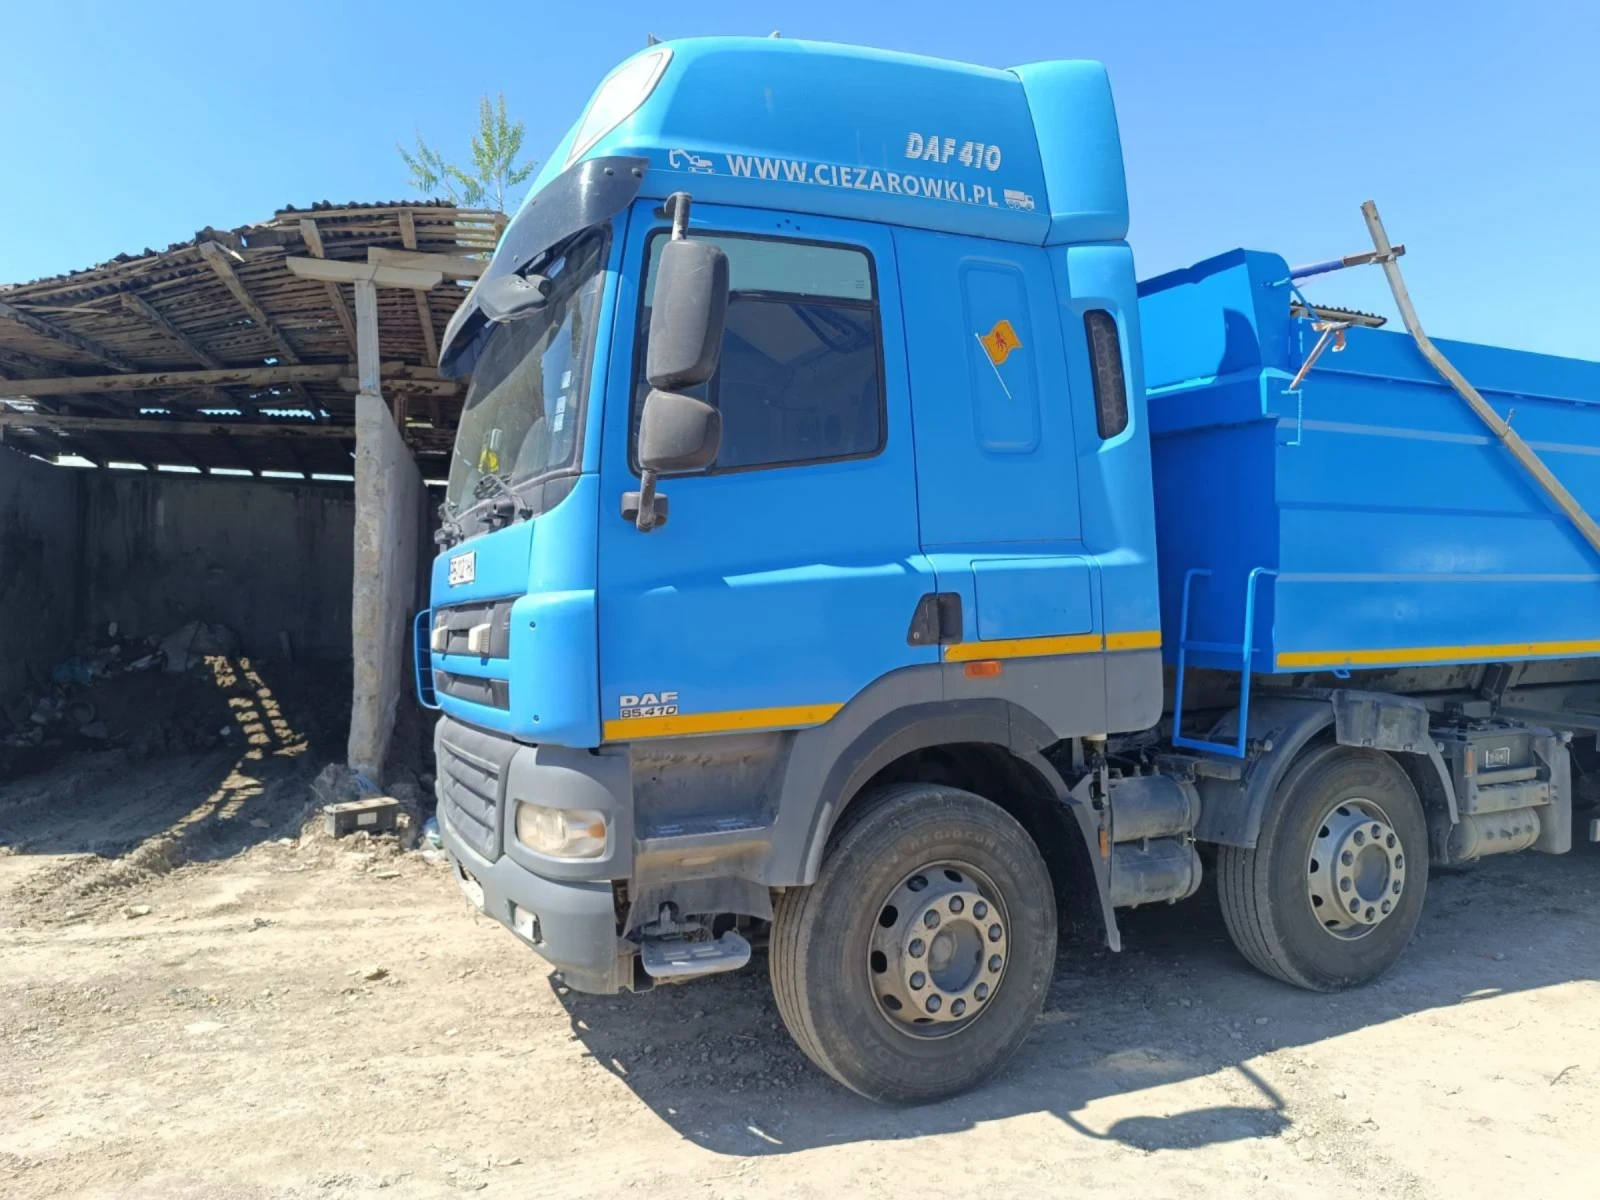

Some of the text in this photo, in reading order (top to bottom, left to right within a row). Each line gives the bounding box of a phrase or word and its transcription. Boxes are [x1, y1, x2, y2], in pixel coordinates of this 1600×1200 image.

[904, 132, 1001, 171] DAF 410
[726, 154, 998, 207] WWW.CIEZAROWKI.PL
[620, 691, 678, 707] DAF
[621, 706, 677, 719] 85.410
